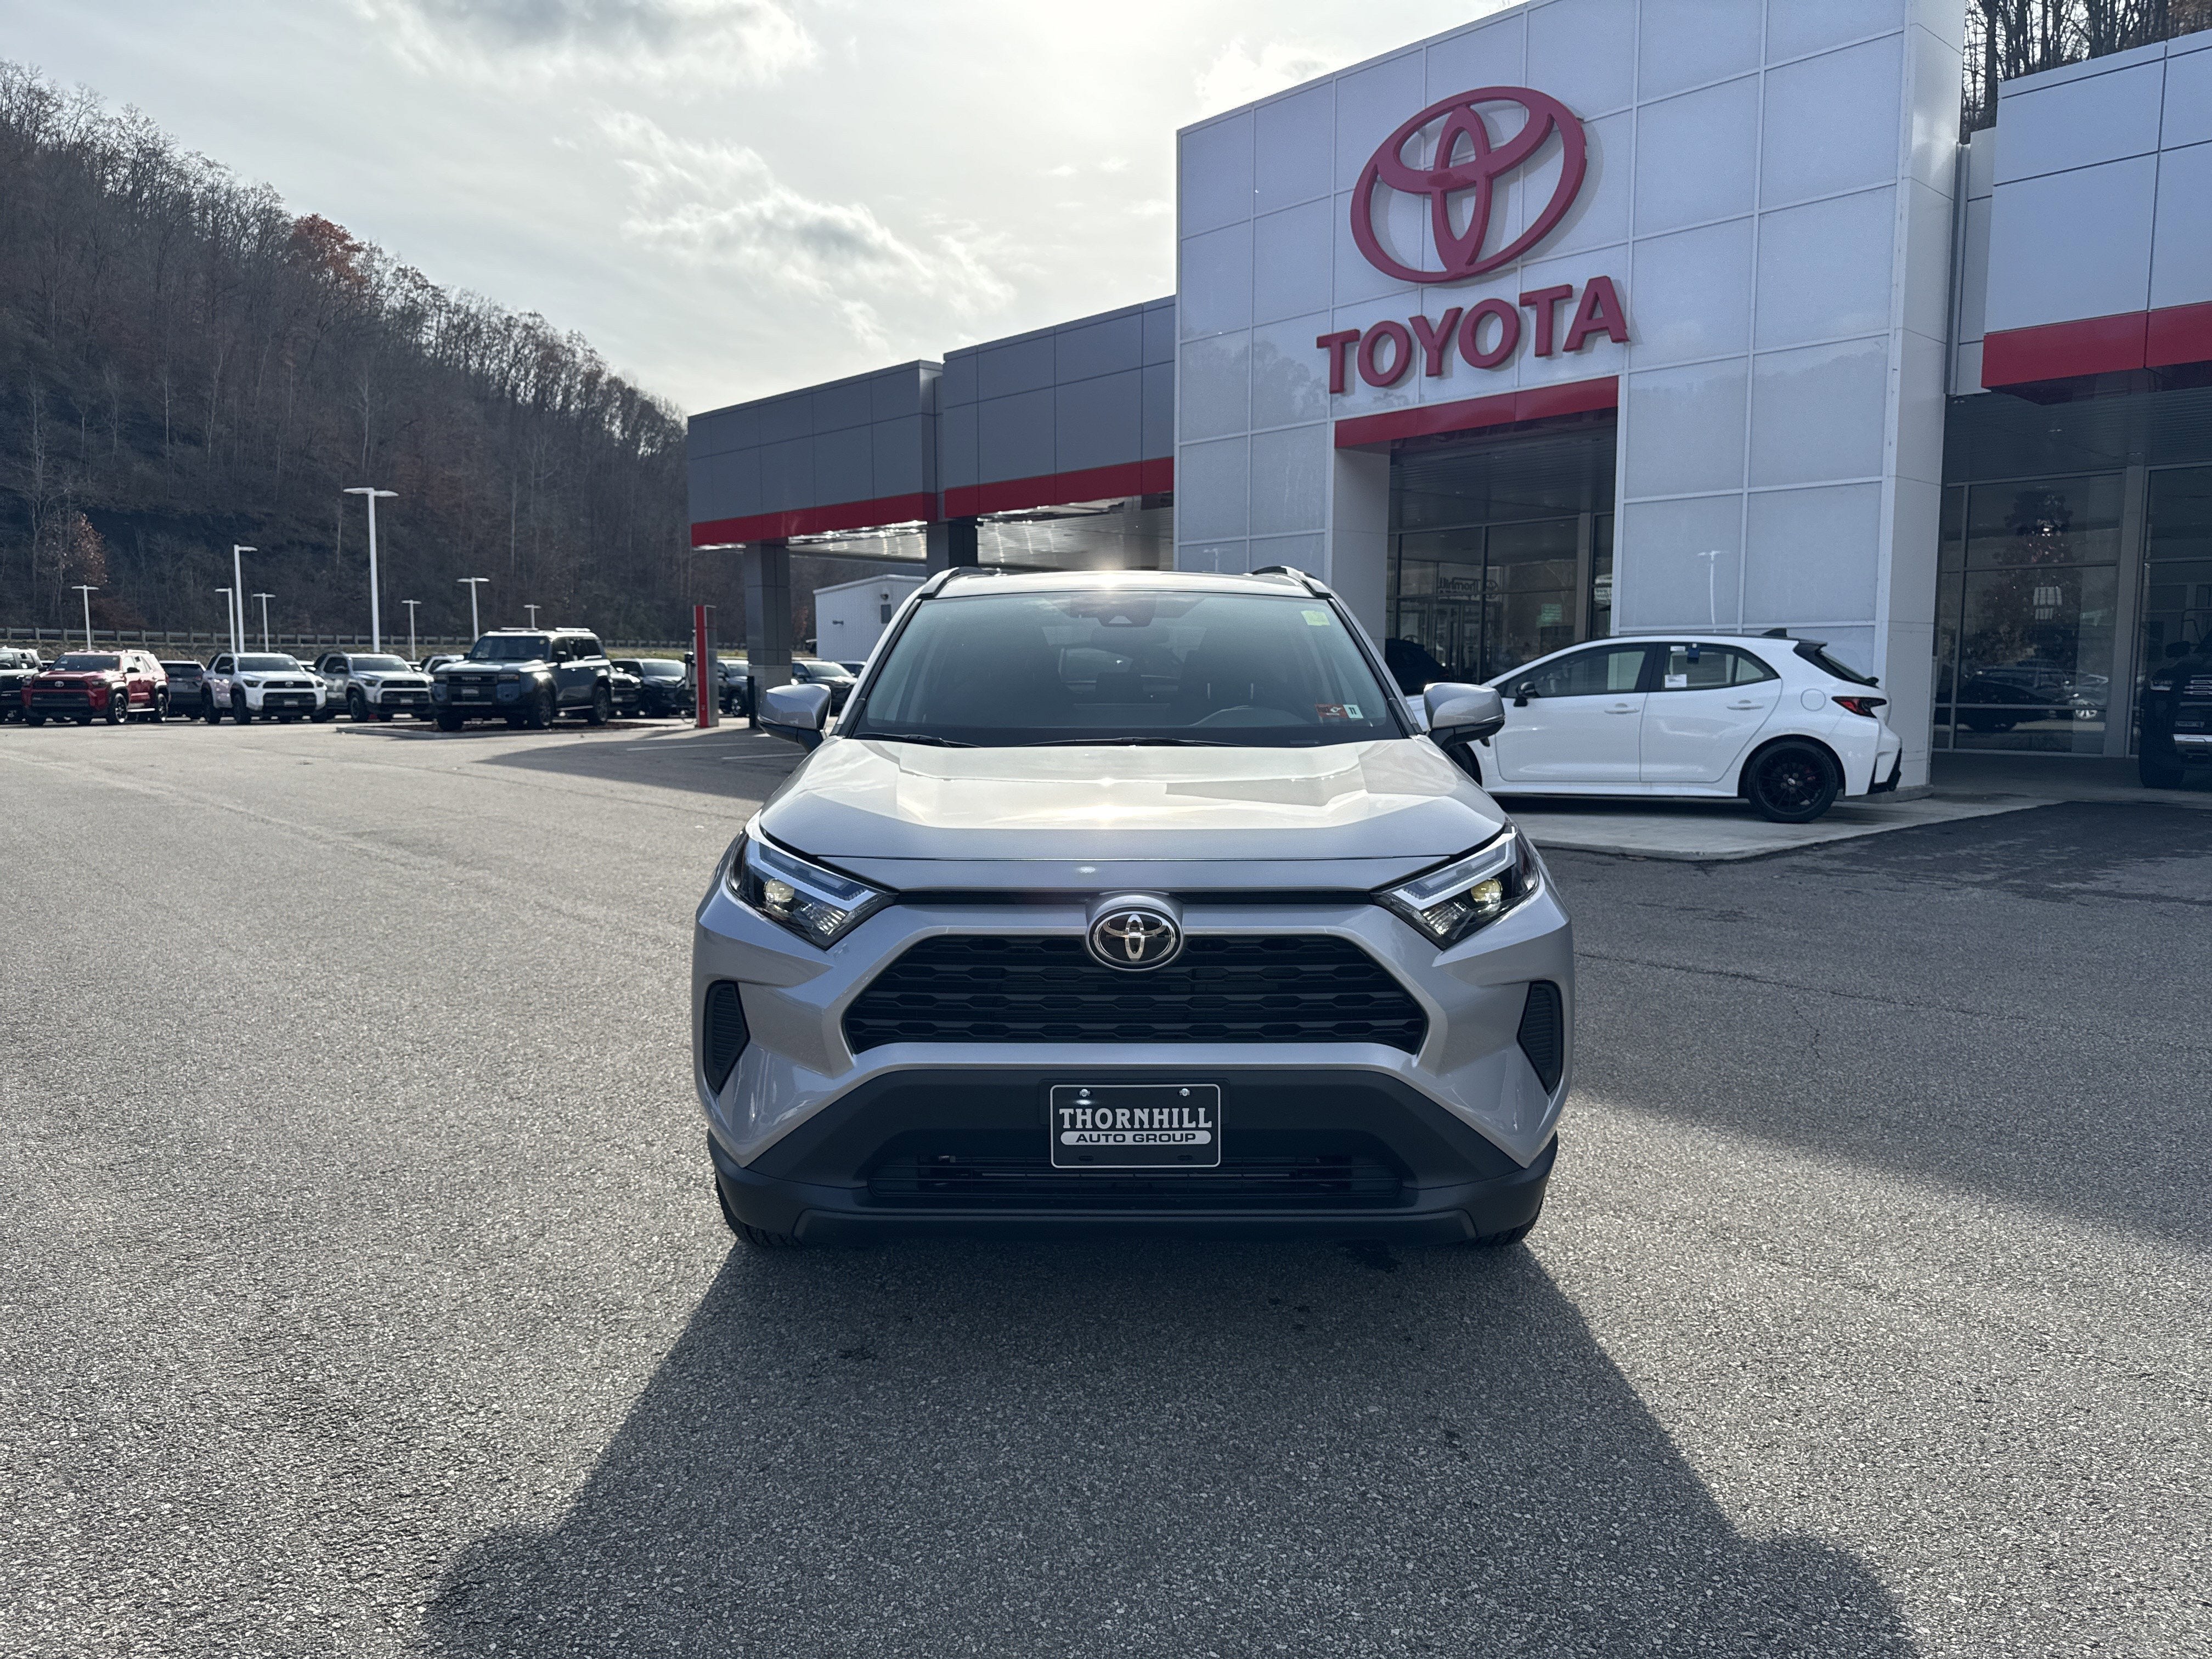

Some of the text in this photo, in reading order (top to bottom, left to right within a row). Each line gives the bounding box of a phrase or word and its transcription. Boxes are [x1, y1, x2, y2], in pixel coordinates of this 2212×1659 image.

[1316, 275, 1630, 394] TOYOTA
[1059, 1108, 1212, 1129] THORNHILL
[1075, 1133, 1196, 1143] AUTO GROUP
